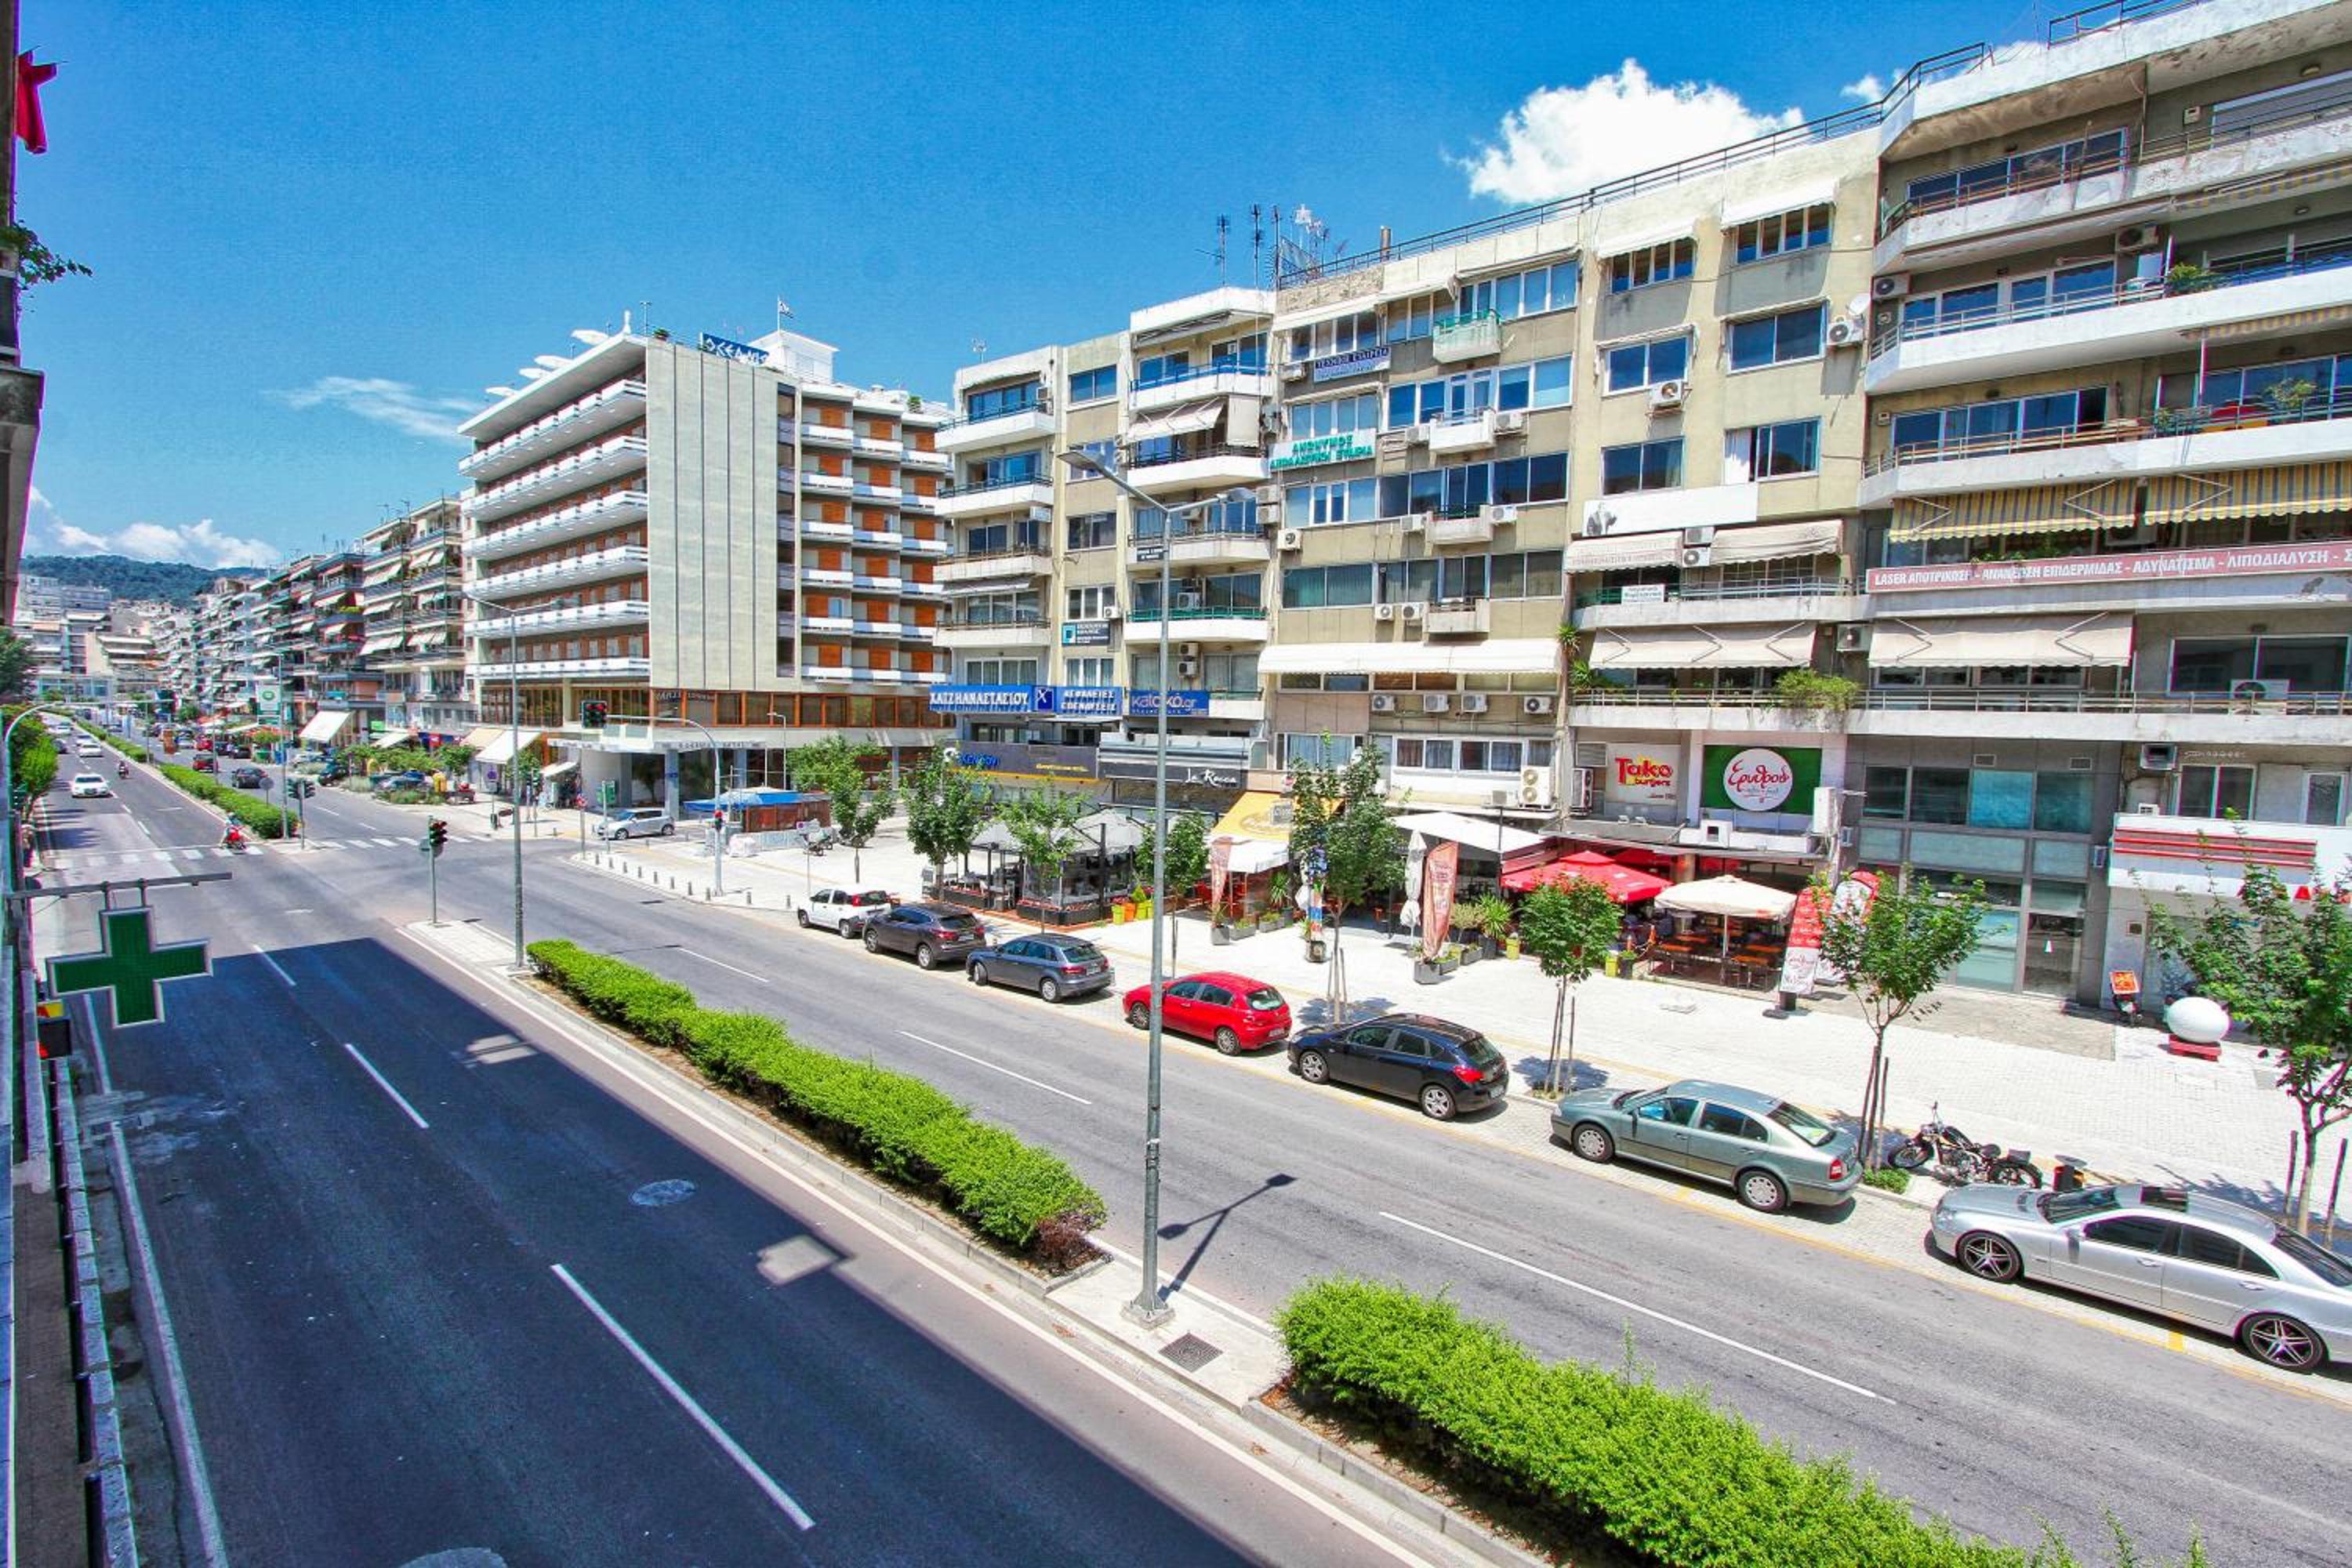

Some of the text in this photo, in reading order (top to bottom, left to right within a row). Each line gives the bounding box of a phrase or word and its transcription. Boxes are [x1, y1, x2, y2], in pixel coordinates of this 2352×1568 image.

[1875, 572, 1907, 586] LASER
[2043, 561, 2122, 578] ΕΠΙΔΕΡΜΙΔΑΣ
[2227, 550, 2328, 568] ΛΙΠΟΔΙΑΛΥΣΗ
[1203, 768, 1237, 787] Rocca
